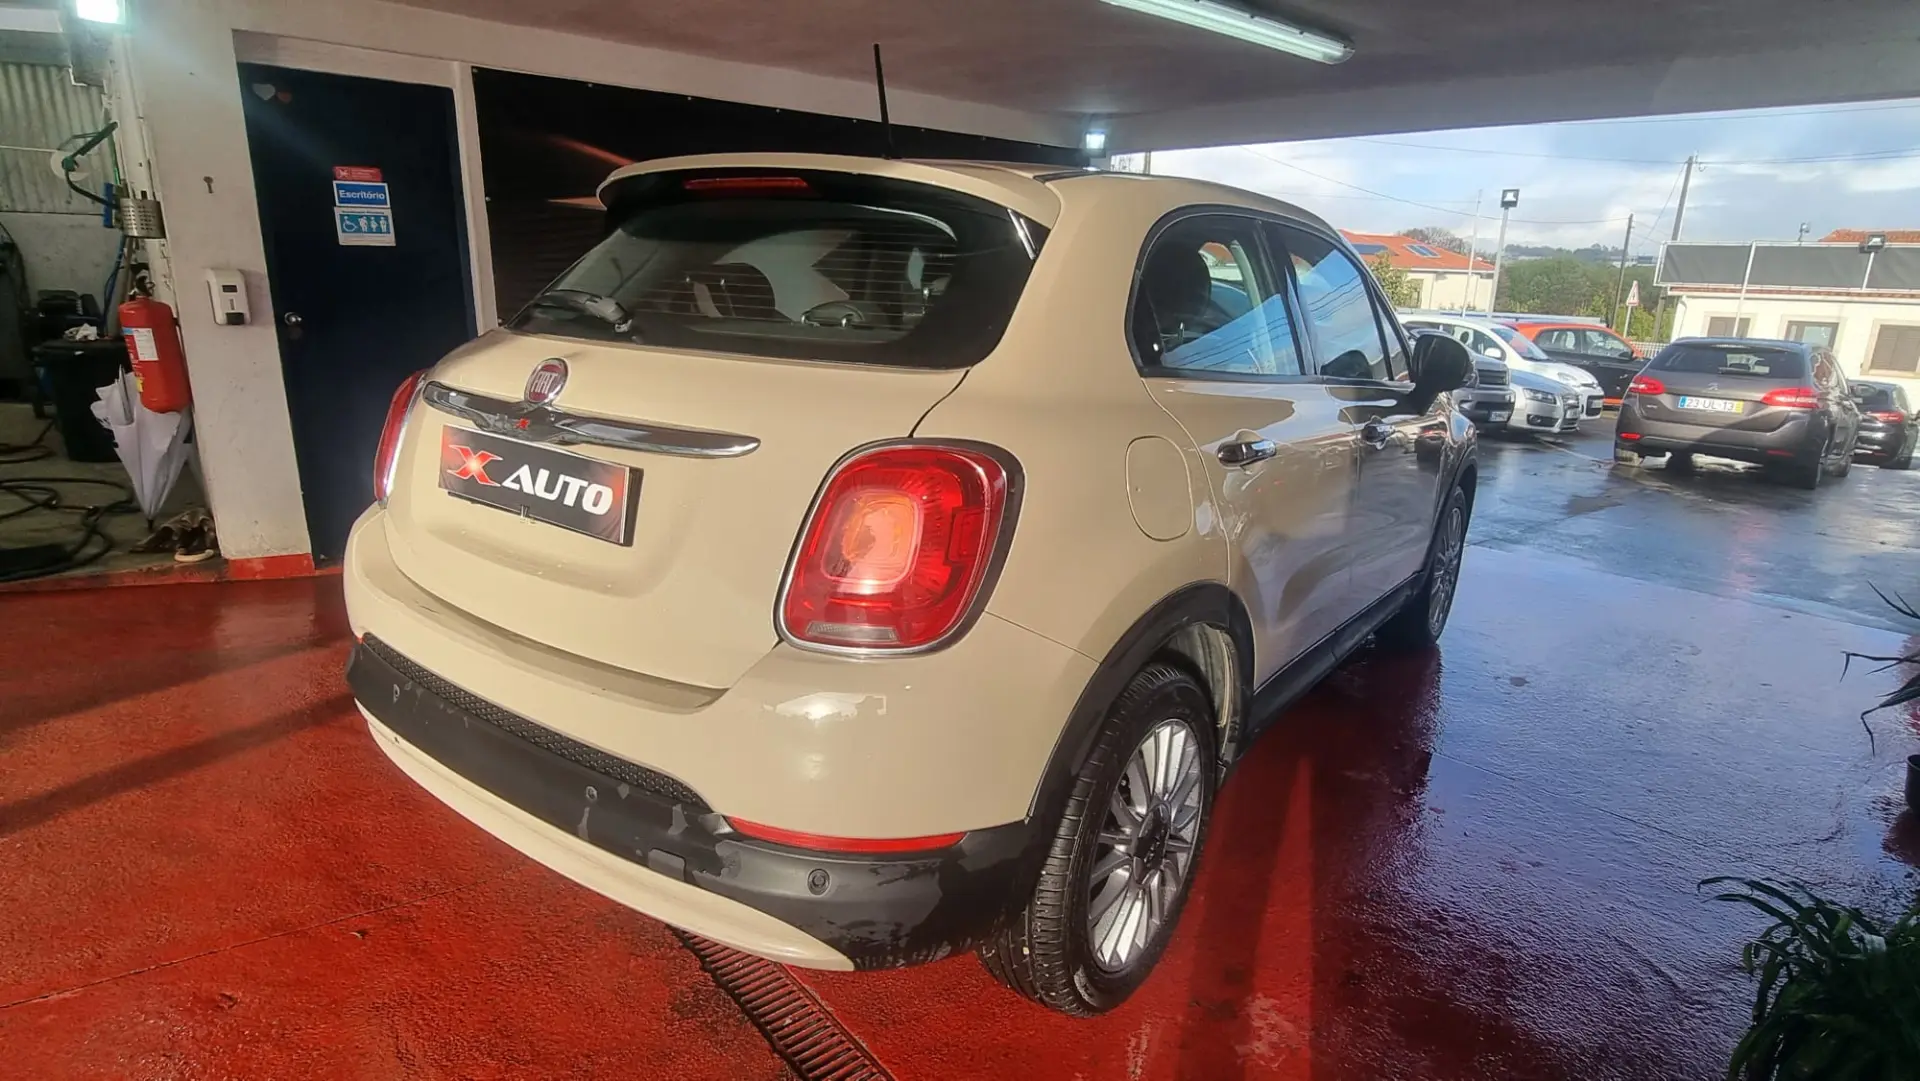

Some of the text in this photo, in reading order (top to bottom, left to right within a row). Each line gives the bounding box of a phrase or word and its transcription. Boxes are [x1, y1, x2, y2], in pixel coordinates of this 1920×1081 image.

[339, 189, 386, 200] Escritório
[530, 370, 559, 395] FIAT
[501, 463, 615, 516] AUTO
